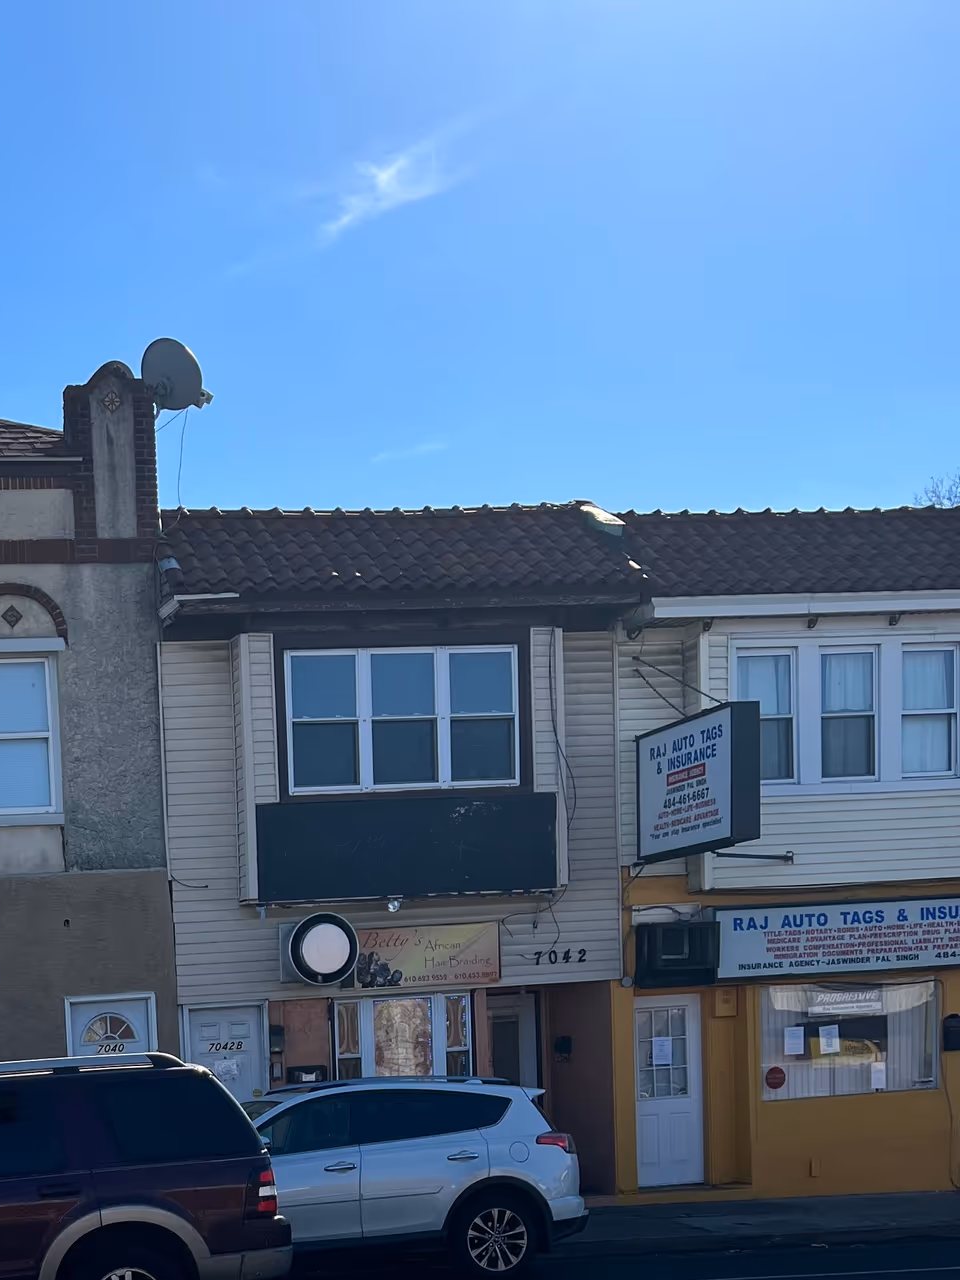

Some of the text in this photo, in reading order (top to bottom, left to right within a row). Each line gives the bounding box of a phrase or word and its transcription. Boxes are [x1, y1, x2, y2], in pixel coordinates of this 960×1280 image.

[650, 724, 723, 761] RAJ AUTO TAGS
[656, 743, 717, 775] & INSURANCE
[663, 787, 709, 809] 484-461-6667
[733, 916, 769, 931] RAJ
[781, 913, 828, 928] AUTO
[840, 910, 885, 925] TAGS
[897, 909, 908, 922] &
[424, 938, 461, 952] African
[767, 937, 801, 945] MEDICARE
[805, 934, 845, 943] ADVANTAGE
[766, 944, 800, 953] WORKERS
[822, 948, 863, 957] DOCUMENTS
[424, 954, 493, 969] Hair Braiding
[533, 949, 587, 965] 7042
[738, 961, 784, 971] INSURANCE
[876, 955, 891, 963] PAL
[896, 953, 919, 961] SINGH
[816, 990, 878, 1003] PROGRESSIVE
[97, 1043, 125, 1053] 7040
[208, 1041, 243, 1052] 7042B
